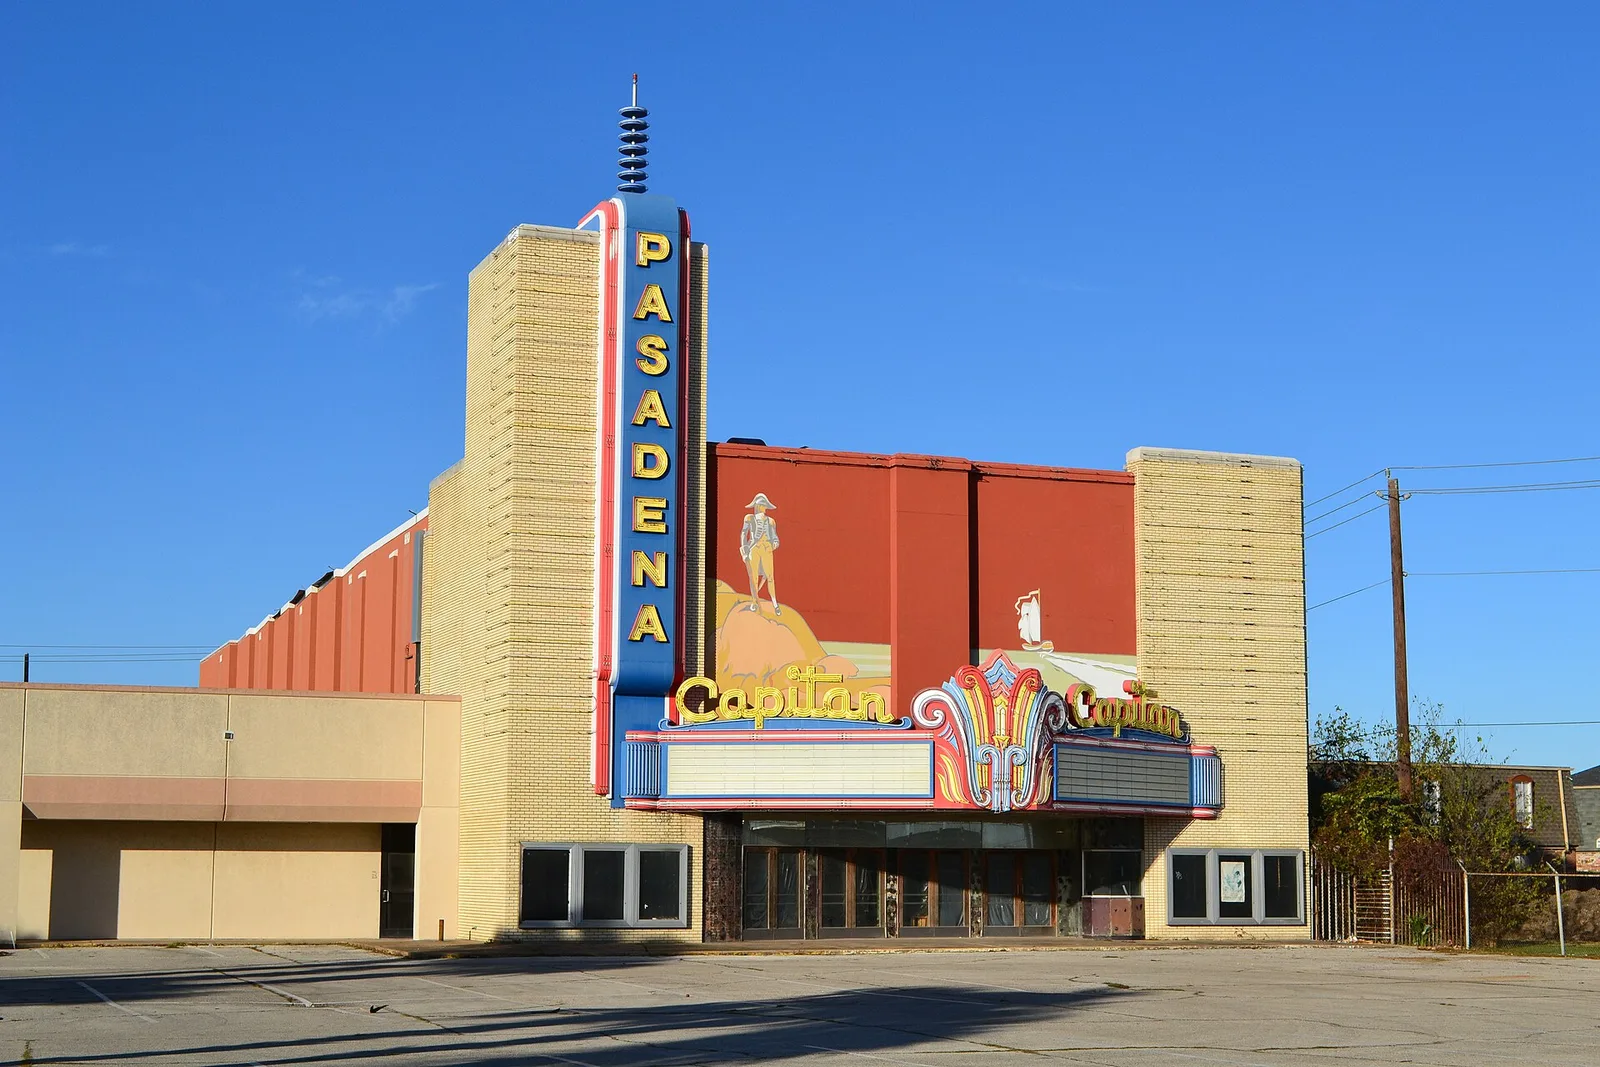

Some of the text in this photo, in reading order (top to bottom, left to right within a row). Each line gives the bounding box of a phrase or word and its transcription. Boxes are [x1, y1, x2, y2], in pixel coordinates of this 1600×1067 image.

[628, 231, 673, 643] PASADENA
[675, 665, 895, 729] Capitan
[1066, 680, 1184, 737] Capitan
